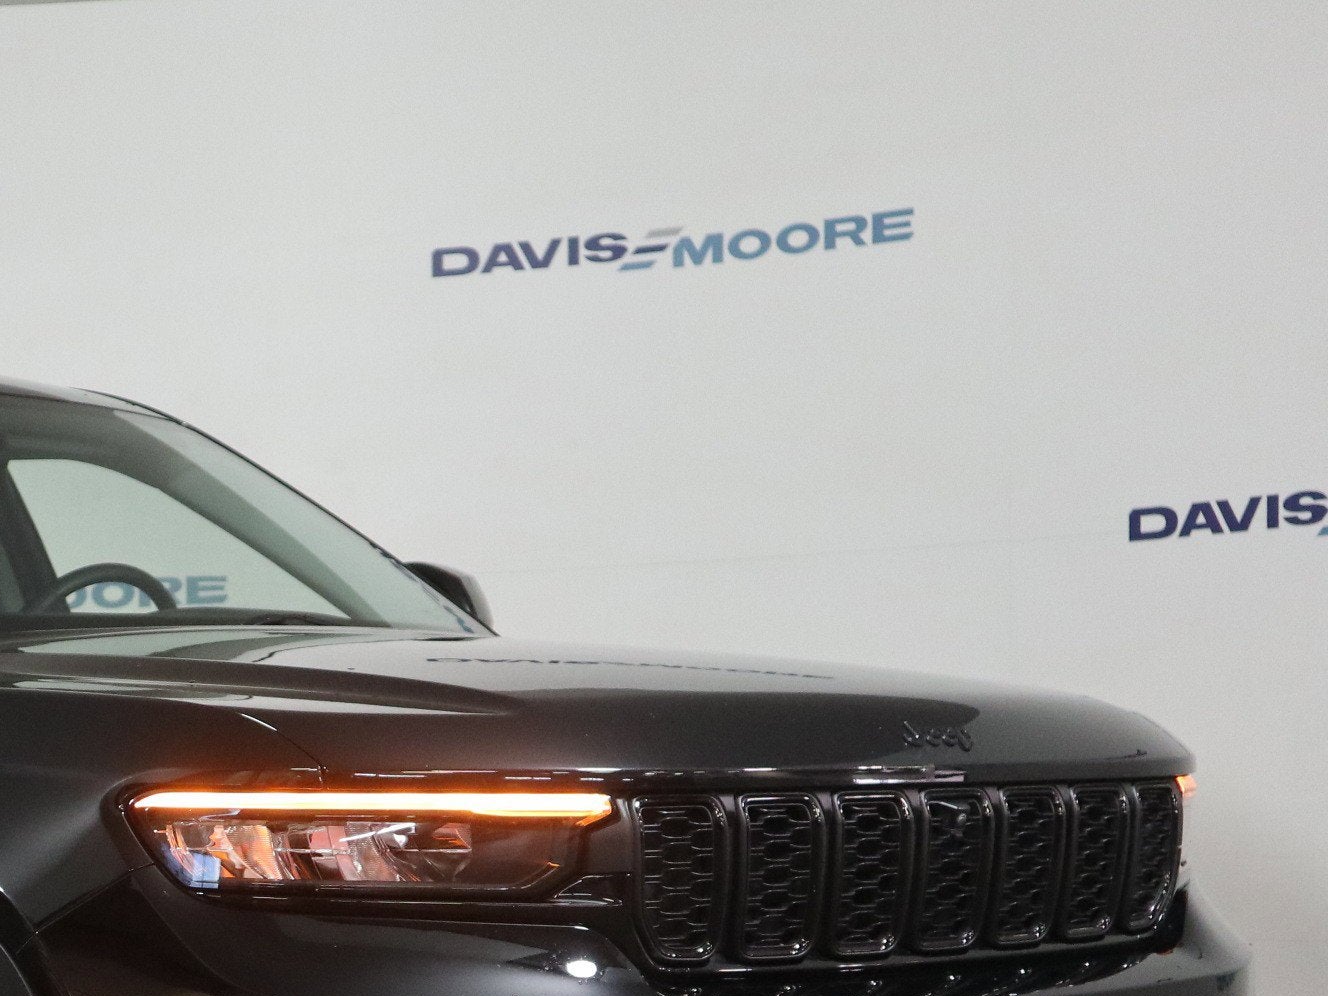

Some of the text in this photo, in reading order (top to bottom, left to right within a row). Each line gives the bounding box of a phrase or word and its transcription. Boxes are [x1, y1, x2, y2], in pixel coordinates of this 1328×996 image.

[431, 207, 915, 278] DAVIS MOORE
[1129, 490, 1328, 542] DAVIS
[903, 720, 972, 752] Jeep
